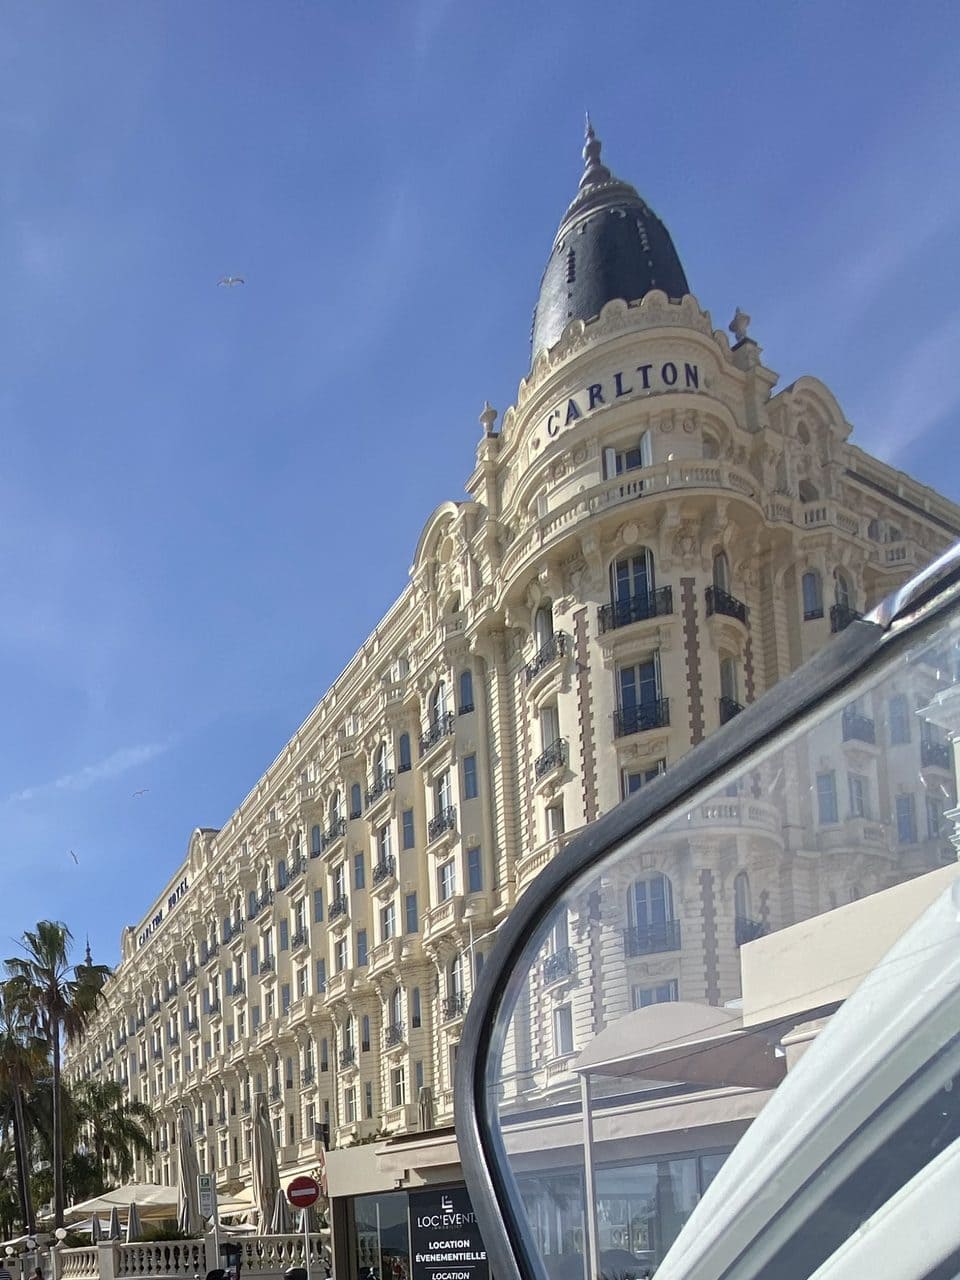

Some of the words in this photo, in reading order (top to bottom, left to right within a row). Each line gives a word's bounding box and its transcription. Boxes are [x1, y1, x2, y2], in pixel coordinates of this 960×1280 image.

[547, 362, 699, 437] CARLTON
[168, 877, 189, 912] HOTEL
[428, 1239, 470, 1250] LOCATION
[415, 1251, 487, 1263] ÉVENEMENTIELLE
[431, 1271, 470, 1280] LOCATION
